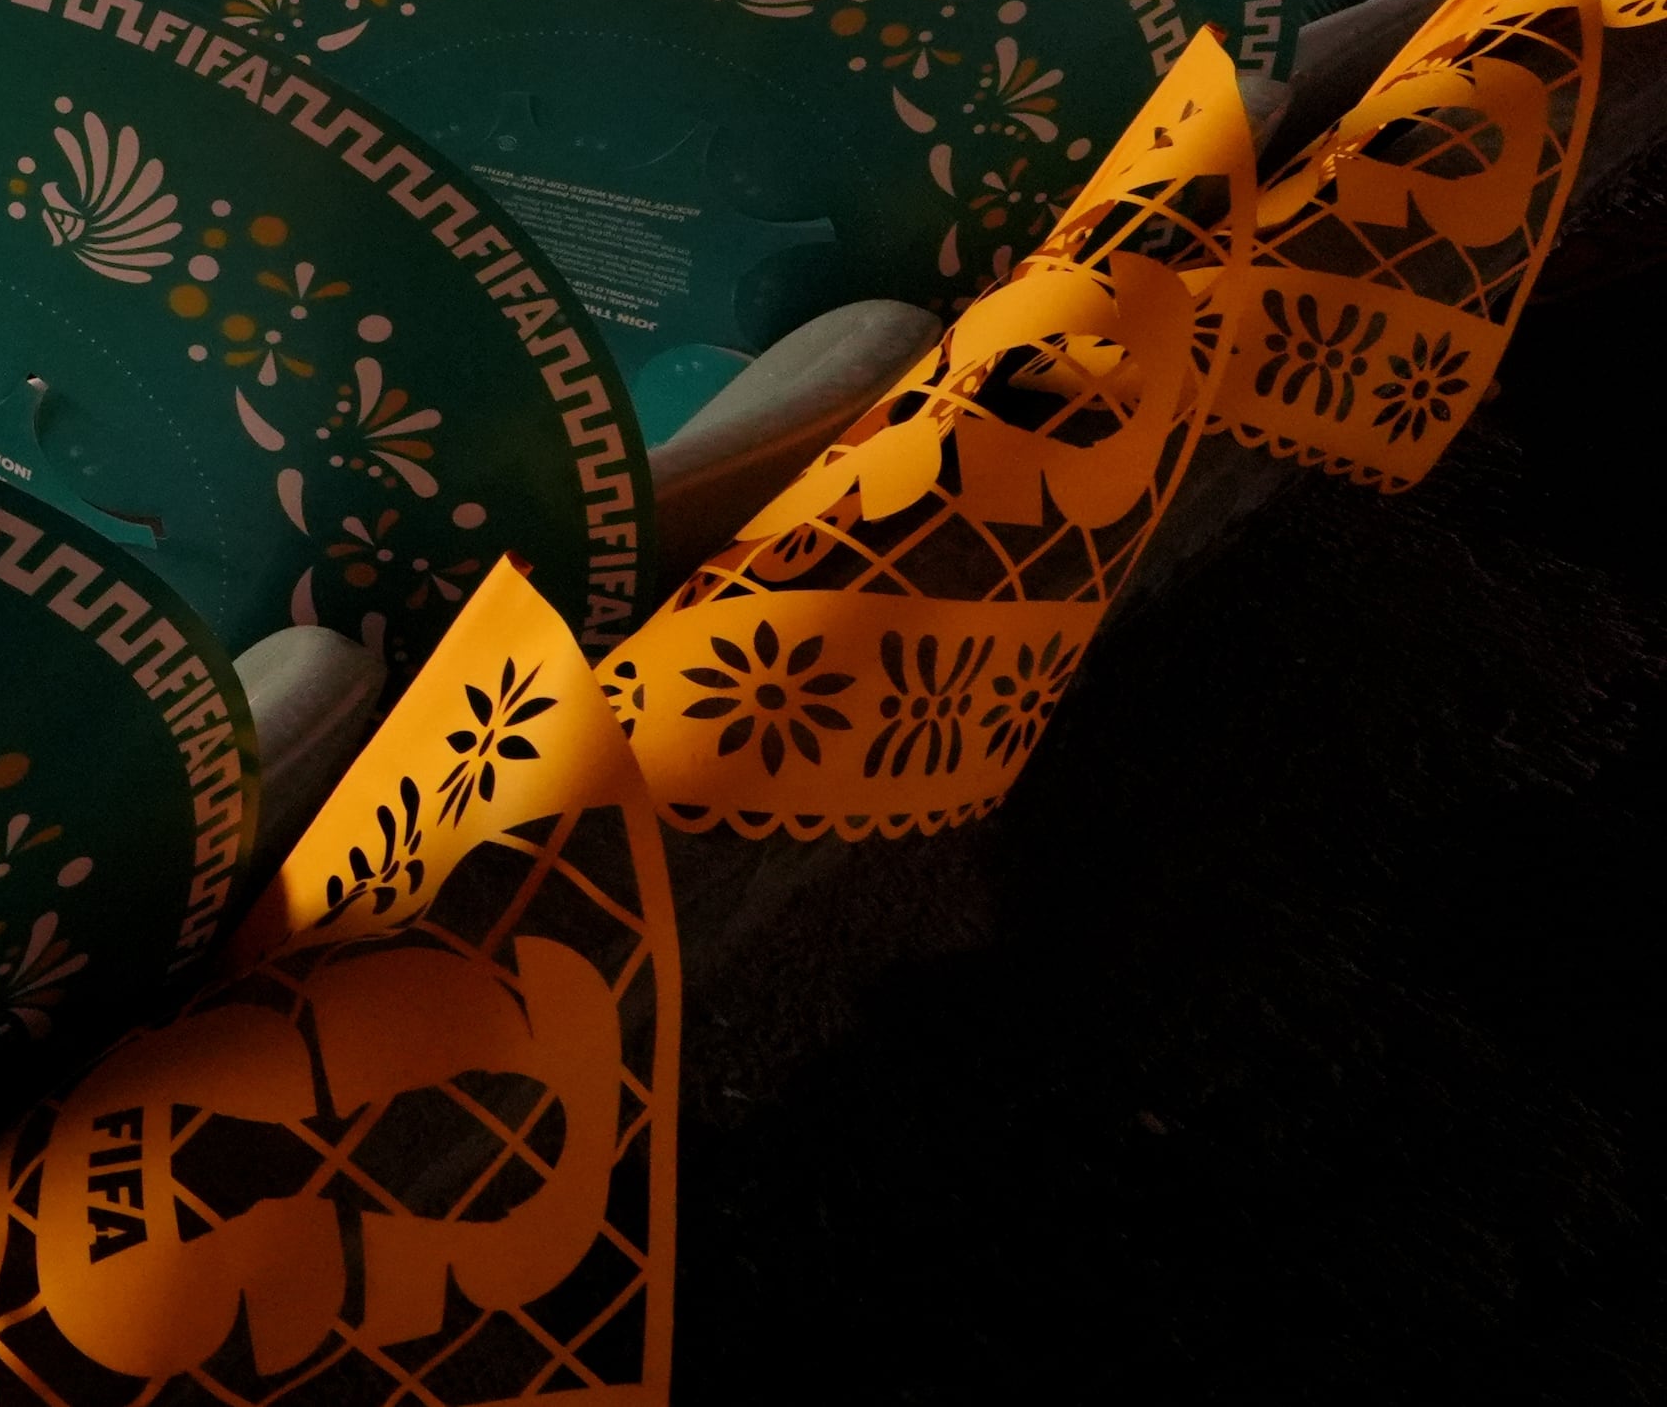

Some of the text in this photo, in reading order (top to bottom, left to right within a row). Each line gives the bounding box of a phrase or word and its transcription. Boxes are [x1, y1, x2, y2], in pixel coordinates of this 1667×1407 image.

[140, 10, 273, 106] FIFA
[458, 224, 565, 349] FIFA
[616, 312, 659, 333] JOIN
[585, 518, 638, 646] FIFA
[147, 655, 235, 775] FIFA
[88, 1106, 147, 1264] FIFA
